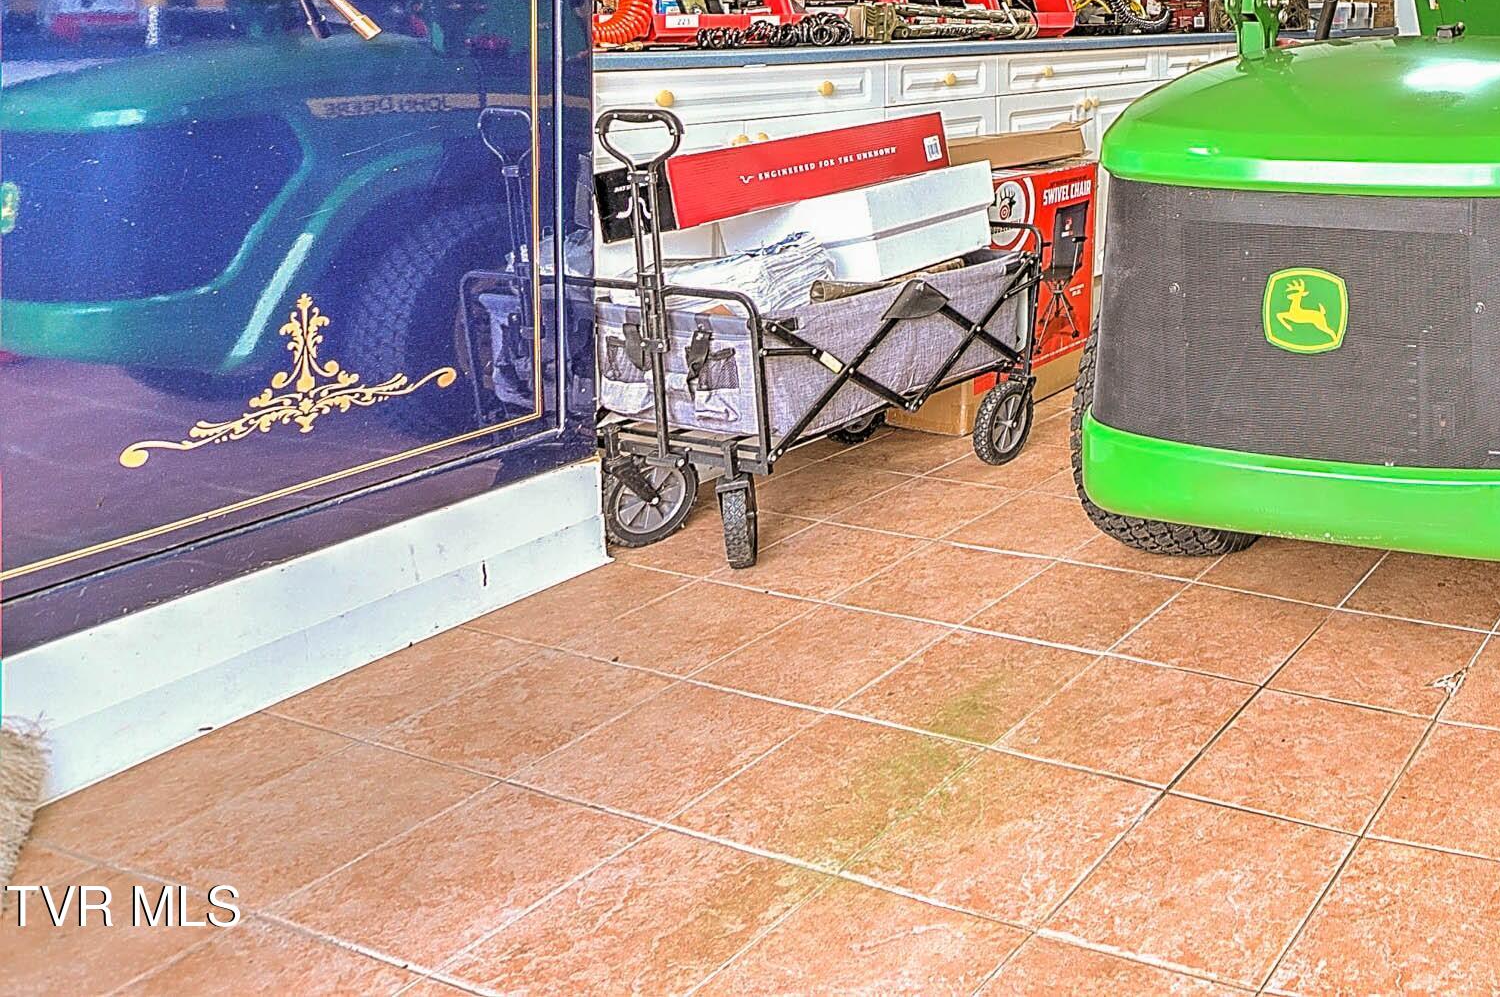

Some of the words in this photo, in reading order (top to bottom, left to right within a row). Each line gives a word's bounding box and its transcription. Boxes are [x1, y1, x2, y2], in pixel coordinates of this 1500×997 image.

[757, 163, 816, 181] ENGINEERED
[819, 159, 835, 168] FOR
[838, 154, 854, 165] THE
[856, 146, 898, 161] UNKNOWN
[1042, 185, 1070, 206] SWIVEL
[1070, 179, 1092, 199] CHAIR
